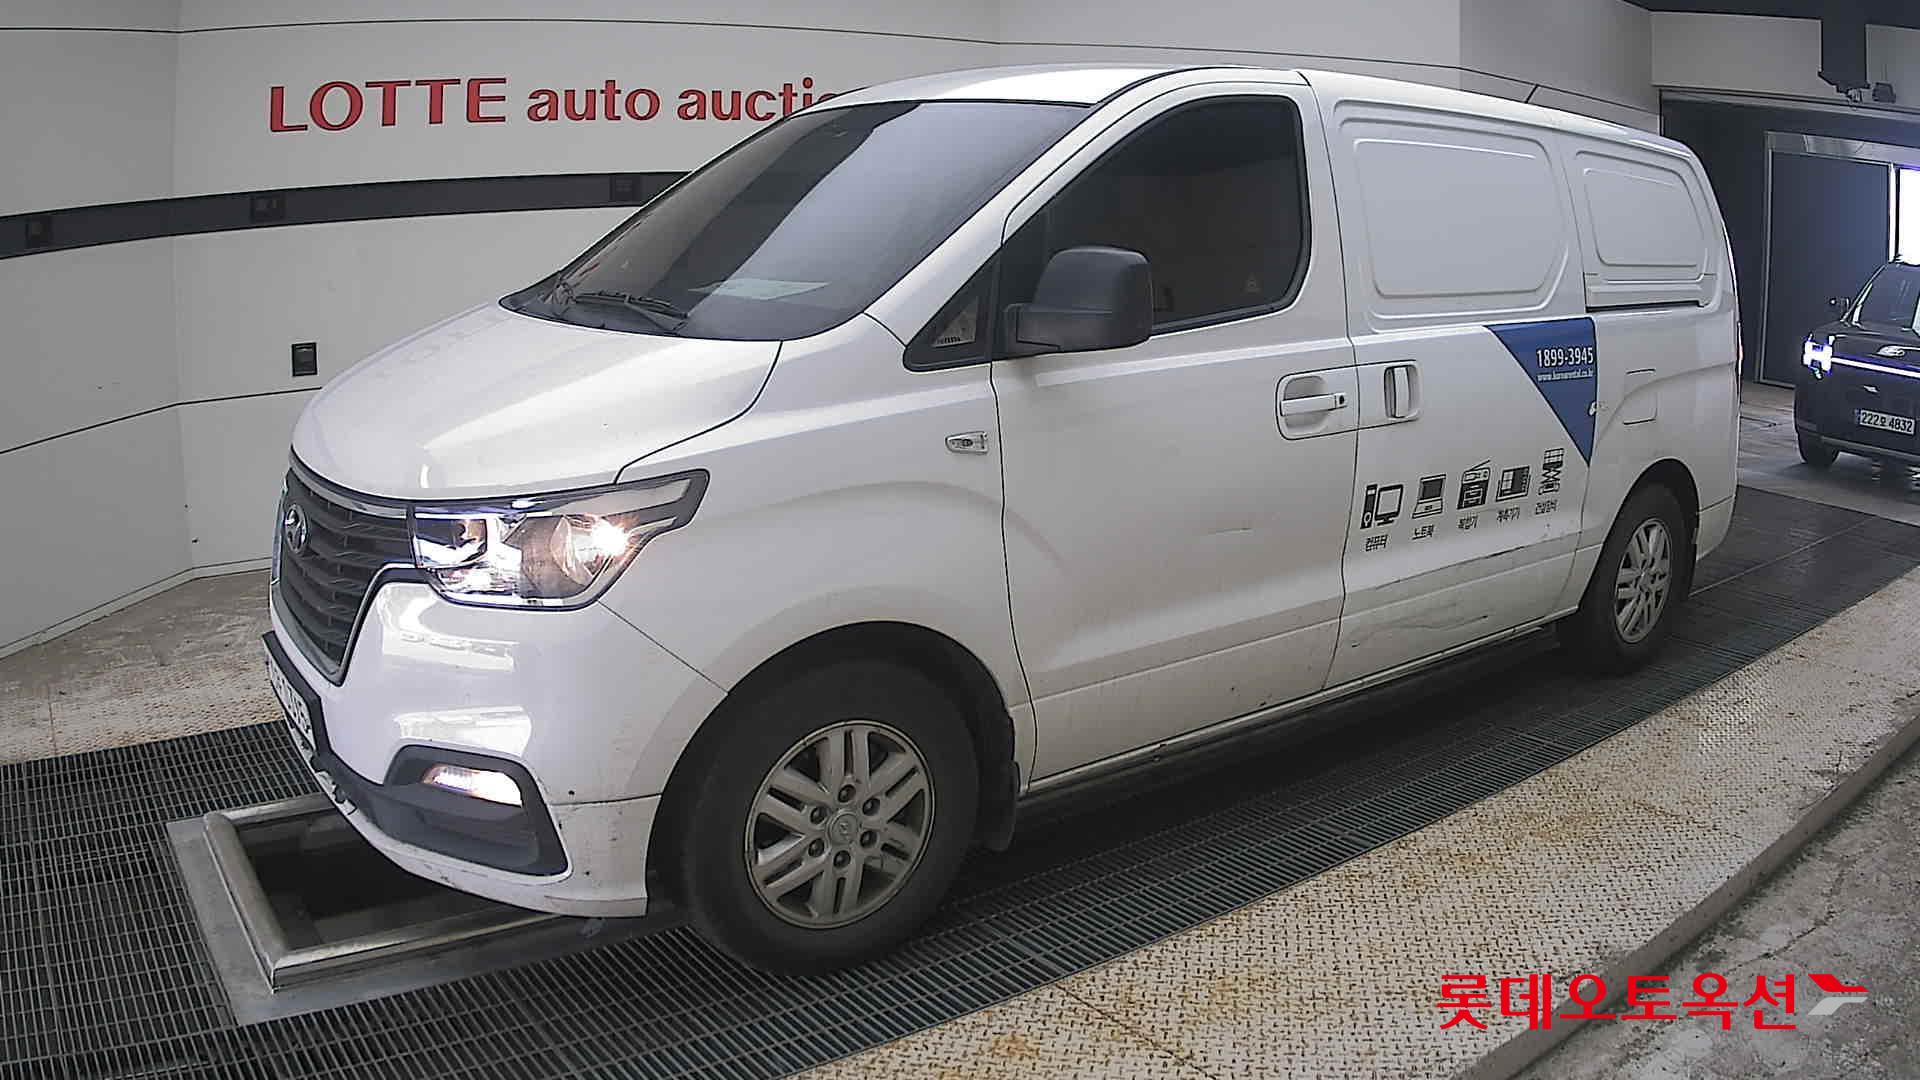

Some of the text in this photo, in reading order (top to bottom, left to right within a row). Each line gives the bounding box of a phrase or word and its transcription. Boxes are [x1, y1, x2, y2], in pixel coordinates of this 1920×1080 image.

[270, 78, 507, 132] LOTTE
[527, 79, 660, 121] auto
[1536, 347, 1594, 367] 1899-3945
[1888, 417, 1913, 432] 4832
[1411, 524, 1434, 541] 노트북
[1365, 534, 1389, 552] 컴퓨터
